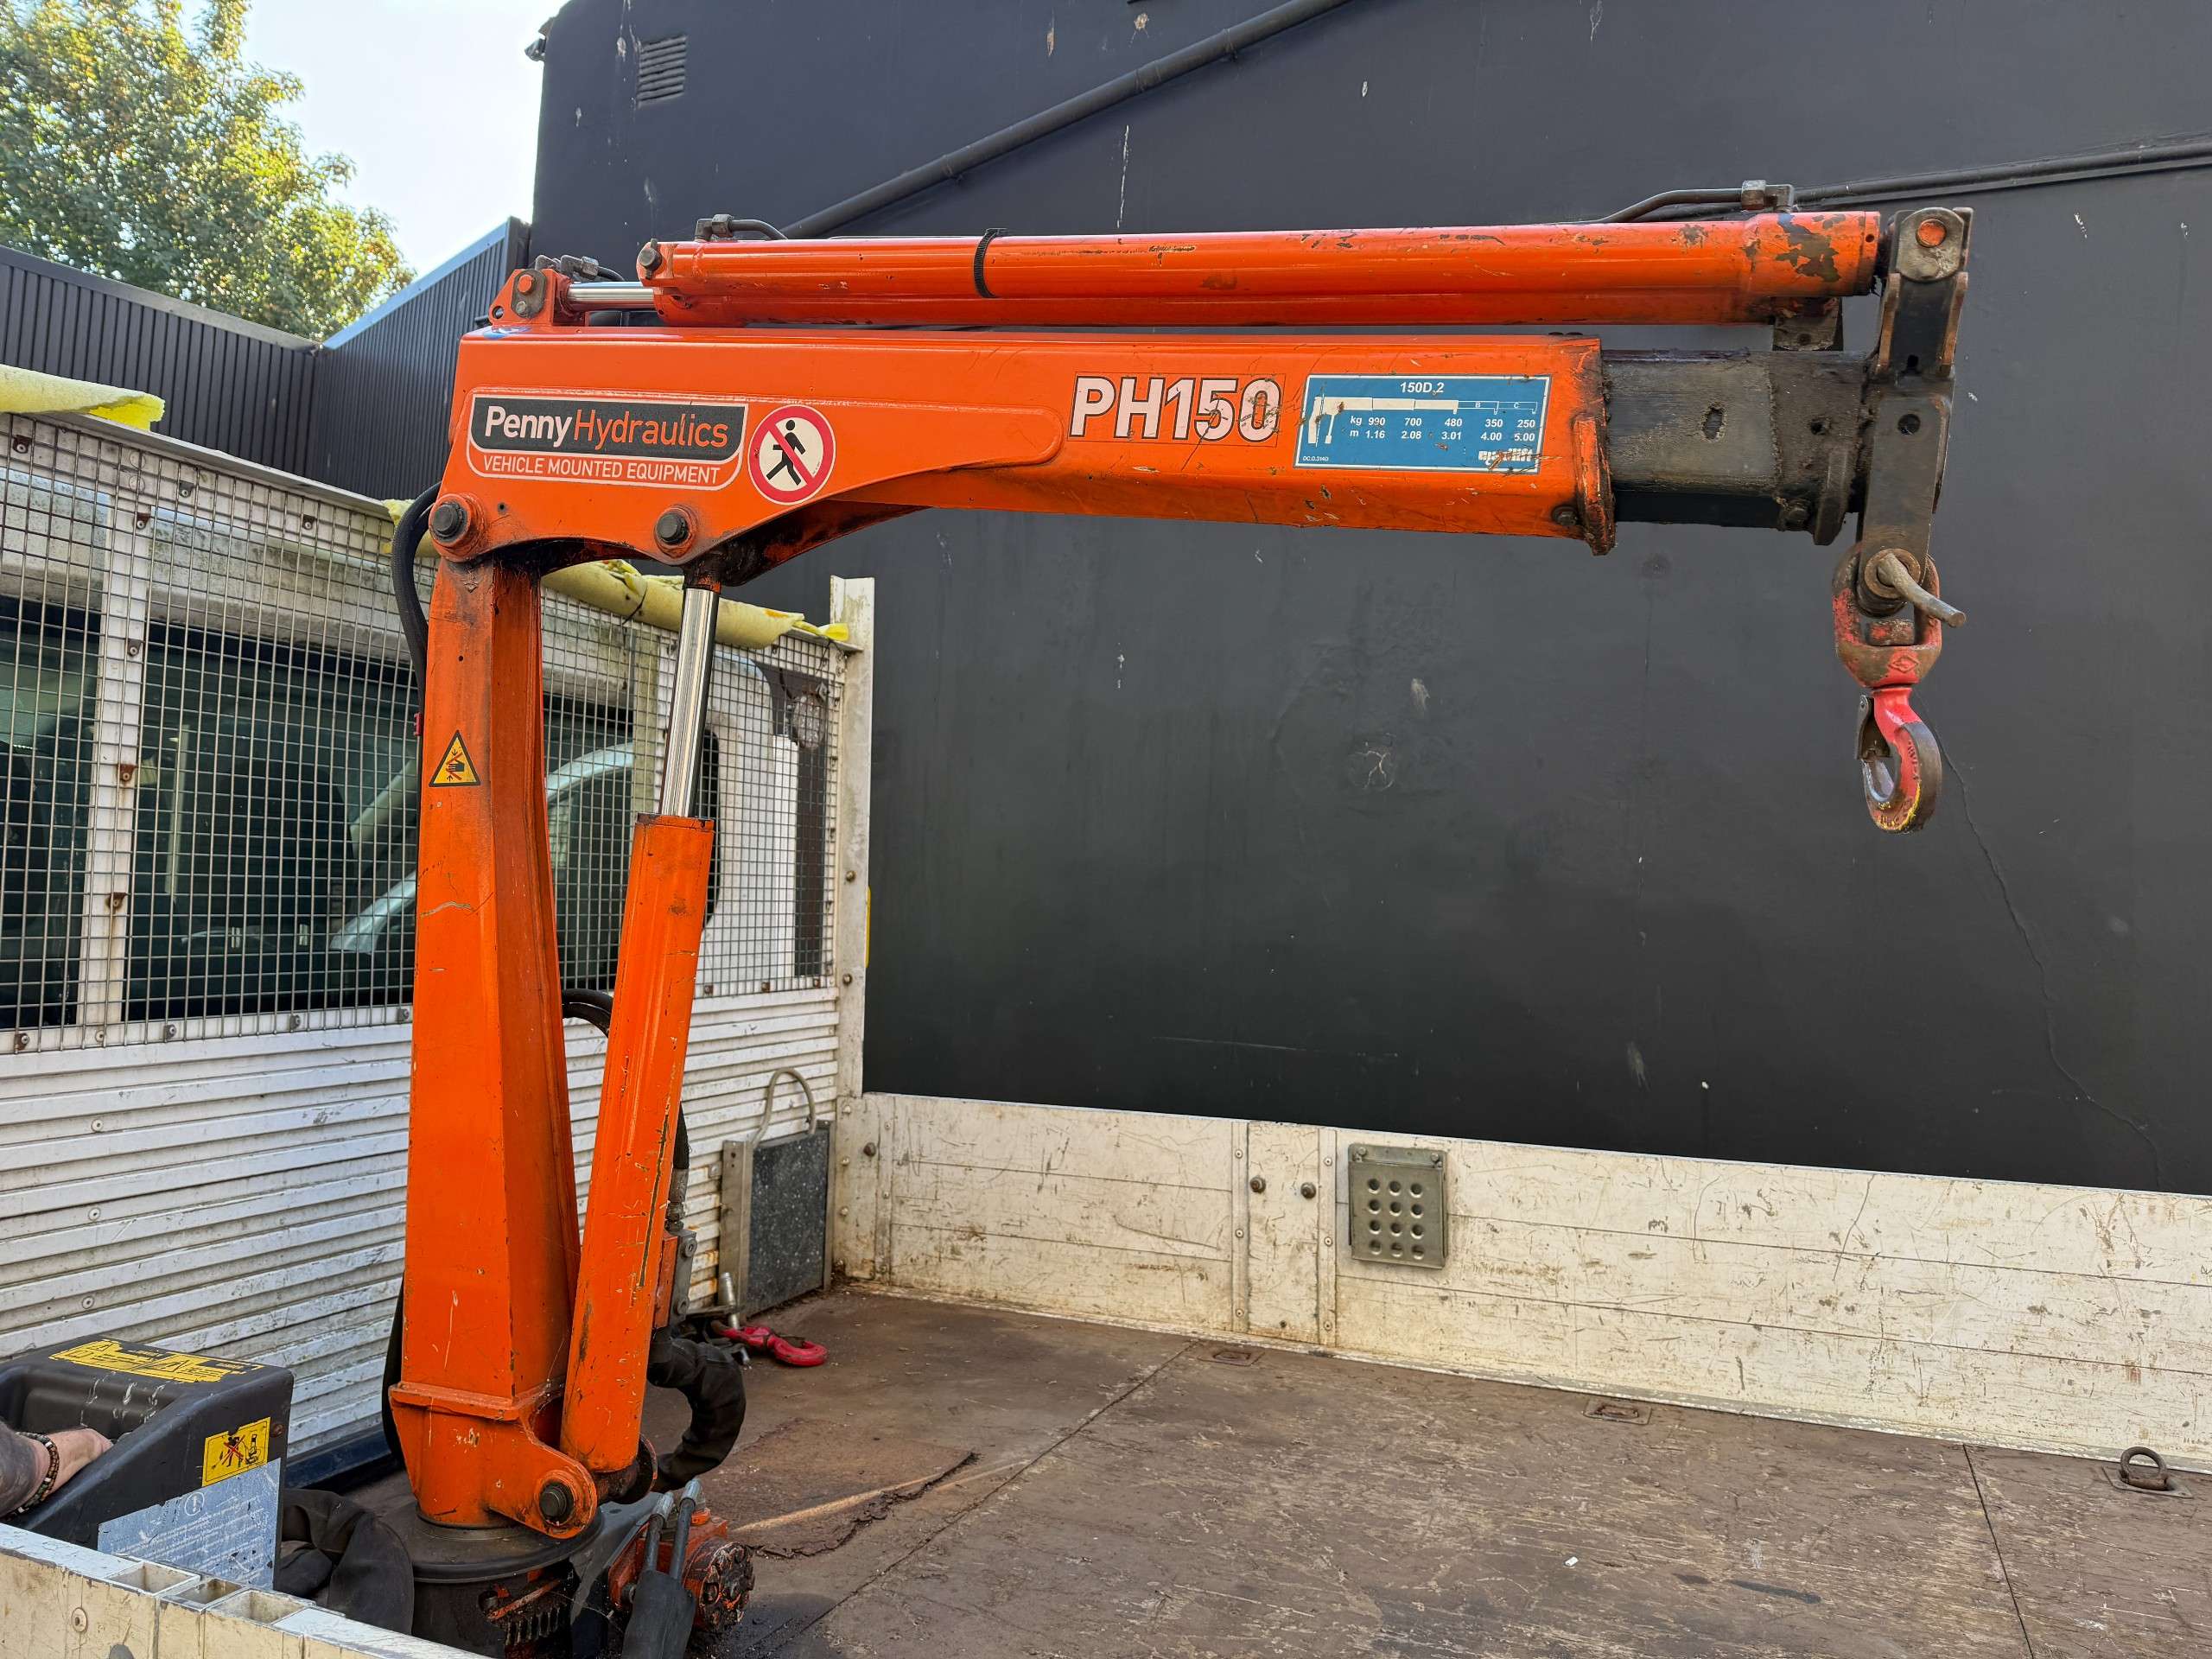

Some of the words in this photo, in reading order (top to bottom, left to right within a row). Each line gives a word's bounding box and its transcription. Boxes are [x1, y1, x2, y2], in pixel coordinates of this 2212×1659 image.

[1069, 376, 1282, 442] PH150
[1350, 416, 1363, 426] kg
[1368, 416, 1386, 426] 990
[1404, 417, 1422, 427] 700
[1444, 417, 1463, 427] 480
[1484, 418, 1503, 428] 350
[1516, 419, 1535, 429] 250
[485, 405, 573, 448] Penny
[574, 409, 728, 450] Hydraulics
[1350, 429, 1359, 438] m
[1365, 429, 1386, 439] 1.16
[1401, 430, 1422, 440] 2.08
[1441, 431, 1463, 440] 3.01
[1480, 432, 1503, 442] 4.00
[1514, 432, 1535, 442] 5.00
[483, 454, 543, 474] VEHICLE
[547, 458, 623, 480] MOUNTED
[626, 462, 721, 484] EQUIPMENT
